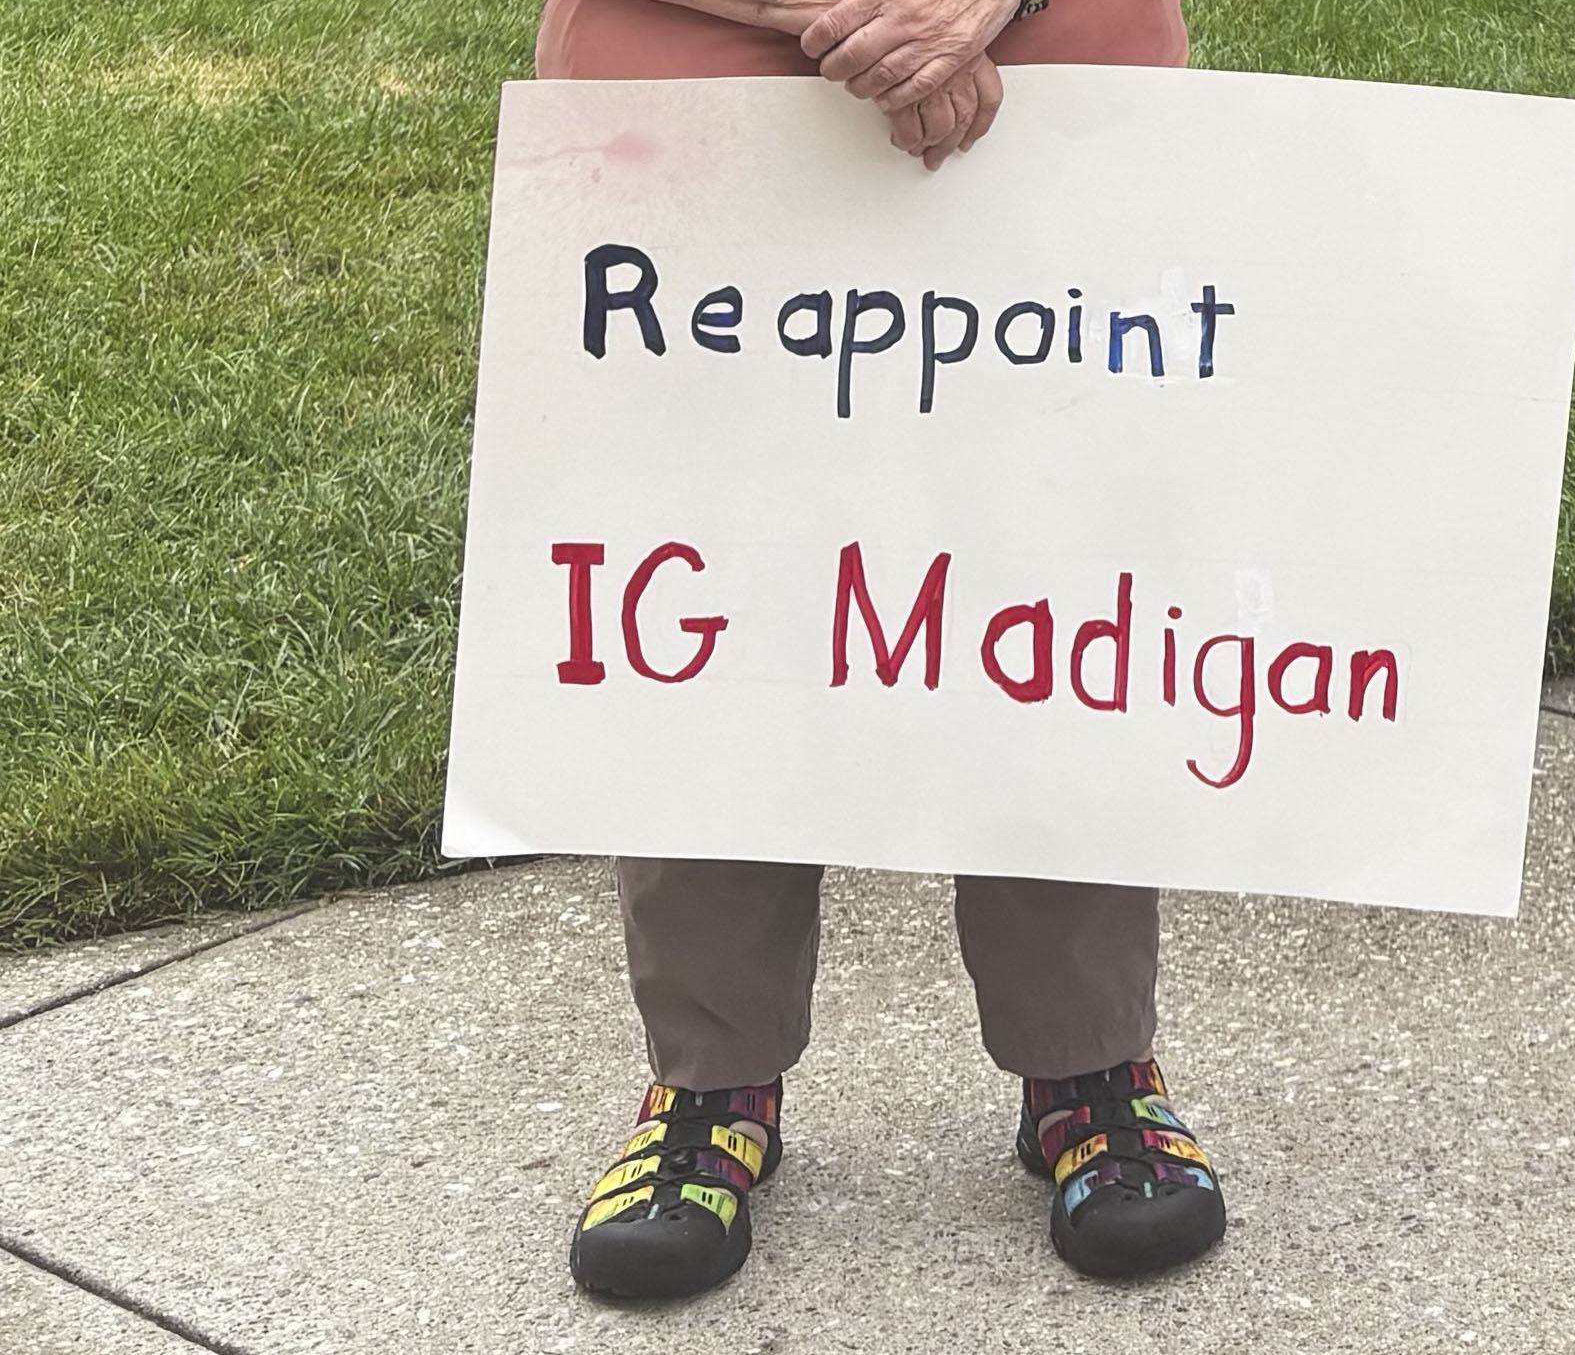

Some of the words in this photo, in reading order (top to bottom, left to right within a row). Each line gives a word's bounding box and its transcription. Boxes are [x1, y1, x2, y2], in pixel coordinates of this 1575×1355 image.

[584, 244, 1234, 418] Reappoint
[552, 542, 728, 685] IG
[830, 542, 1398, 788] Madigan
